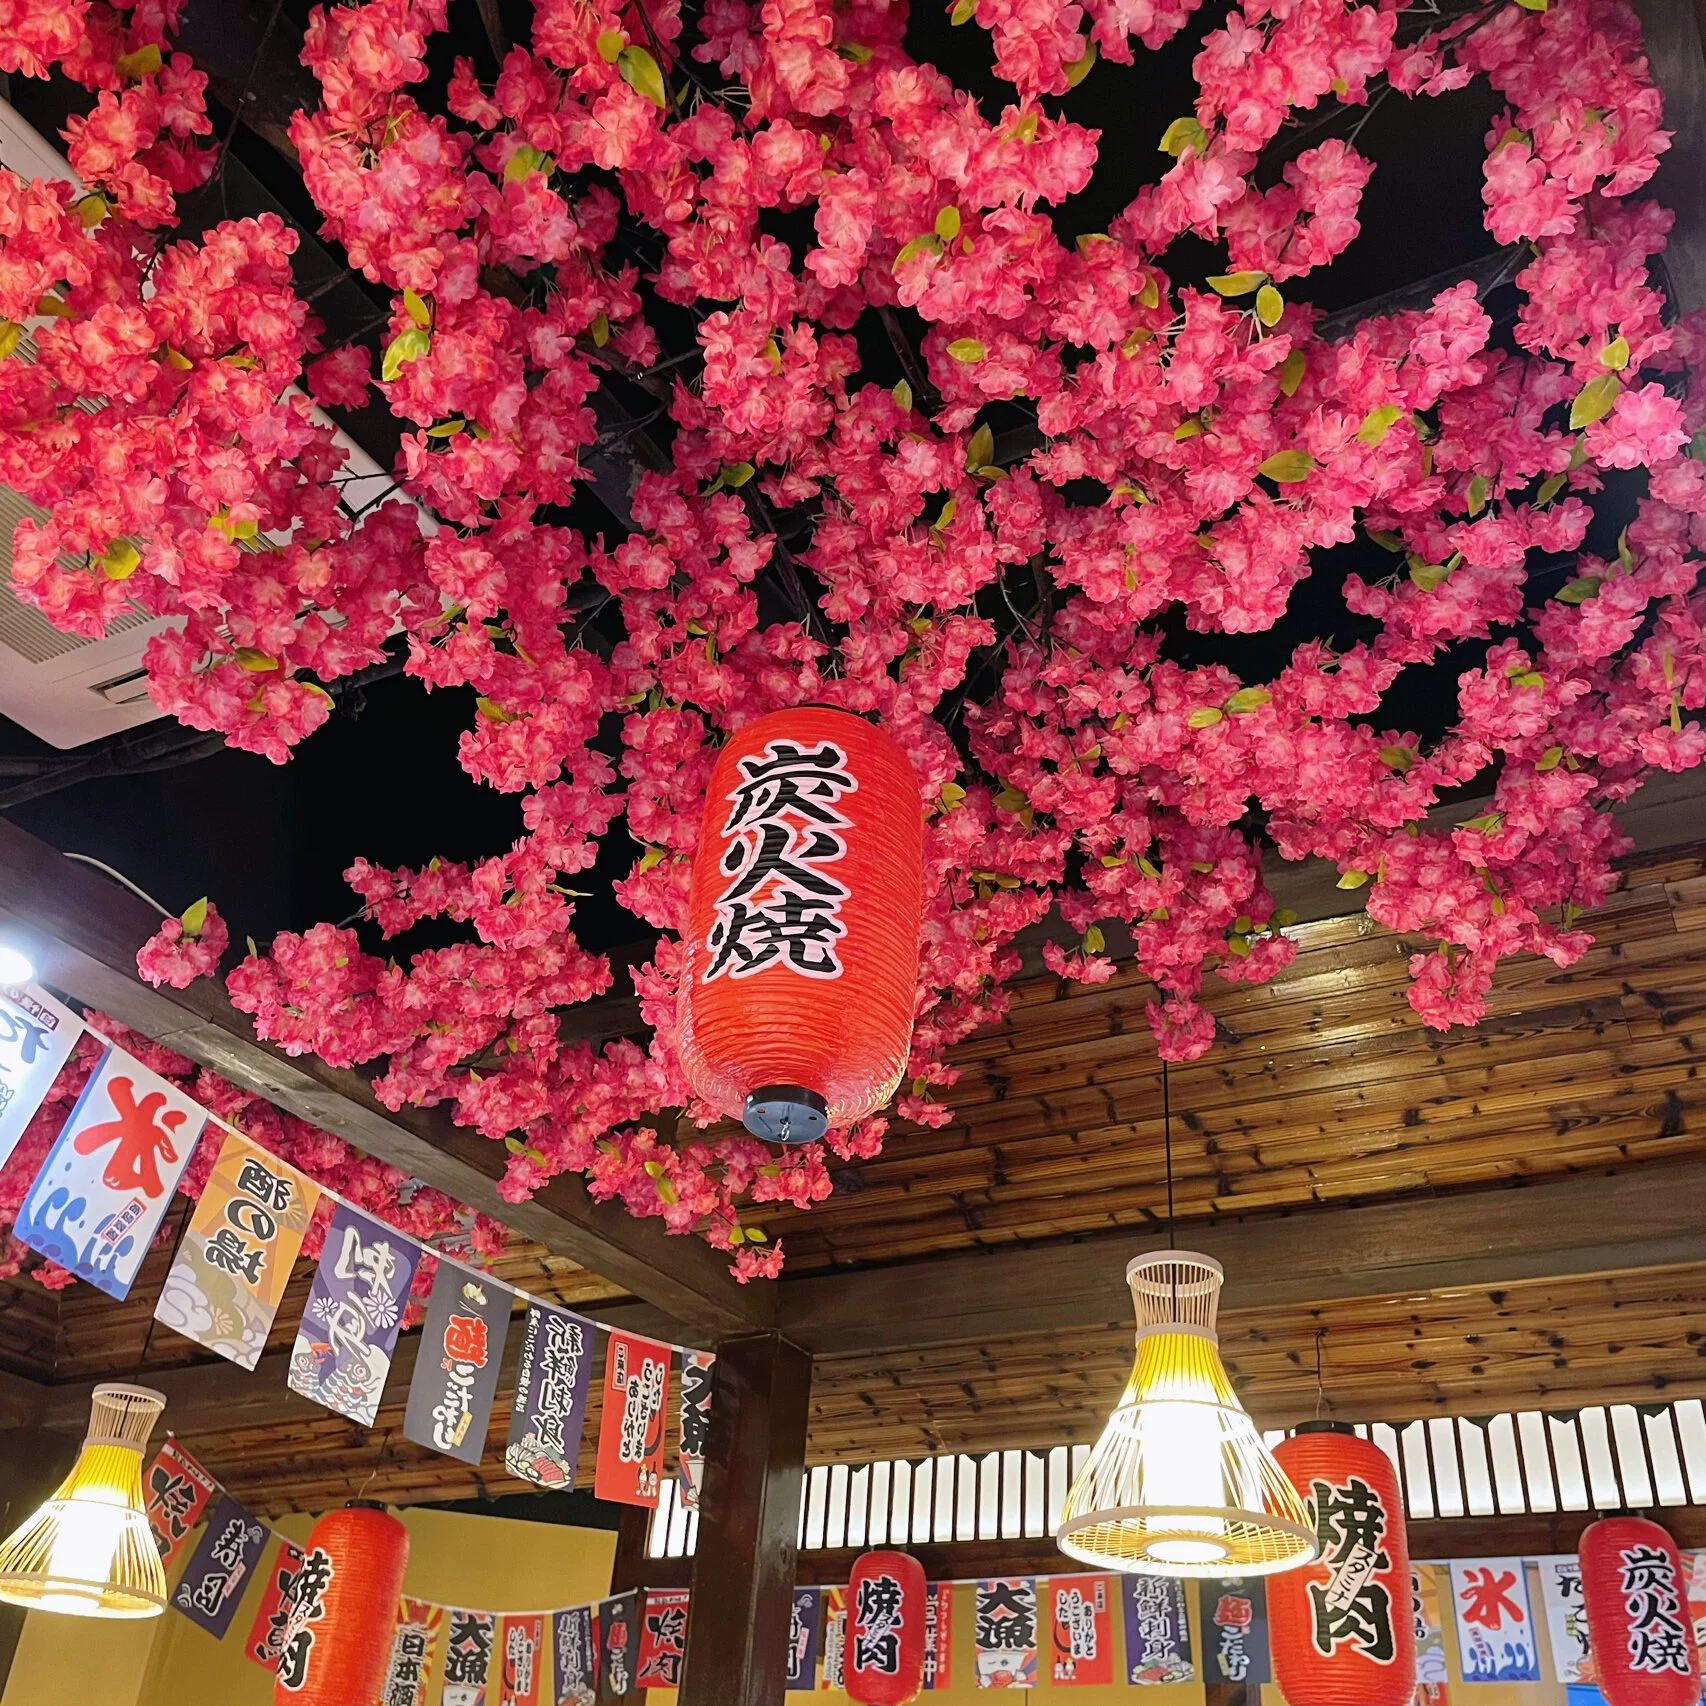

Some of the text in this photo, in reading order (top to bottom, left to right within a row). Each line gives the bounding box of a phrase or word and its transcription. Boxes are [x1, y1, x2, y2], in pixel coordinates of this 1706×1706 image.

[702, 740, 860, 982] 炭火焼
[1309, 1478, 1392, 1662] 焼肉
[1330, 1546, 1375, 1608] スタミナ
[1460, 1567, 1524, 1630] 氷
[1622, 1546, 1690, 1672] 炭火焼
[445, 1614, 492, 1684] 大漁
[856, 1577, 904, 1671] 焼肉
[976, 1583, 1036, 1650] 大漁
[1133, 1577, 1175, 1662] 新鮮刺身
